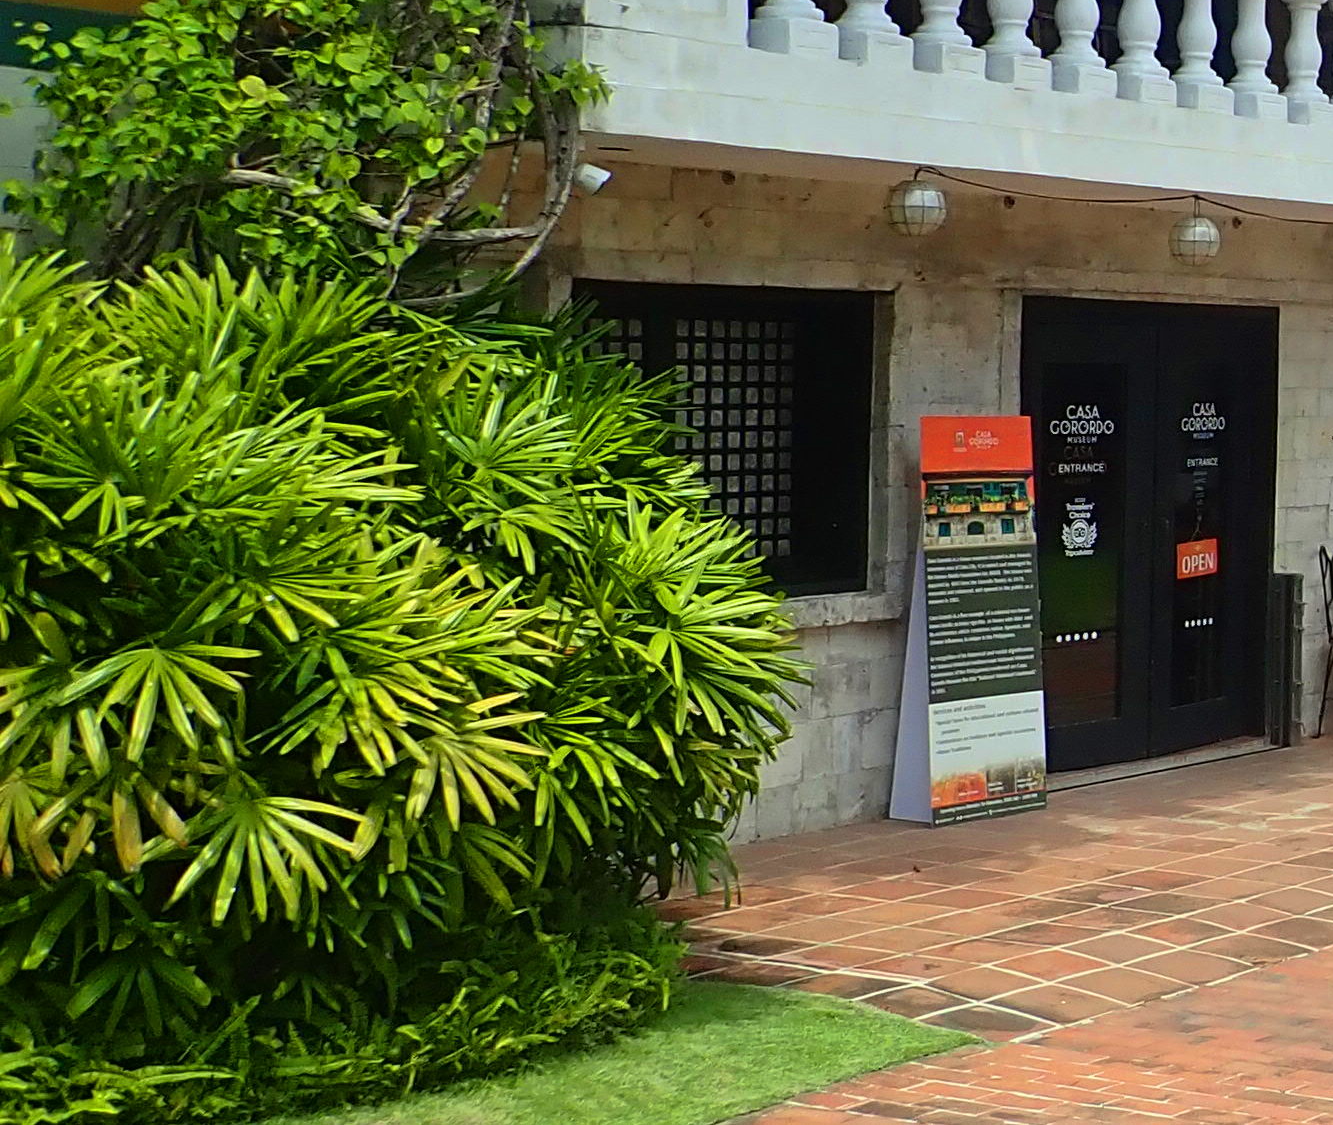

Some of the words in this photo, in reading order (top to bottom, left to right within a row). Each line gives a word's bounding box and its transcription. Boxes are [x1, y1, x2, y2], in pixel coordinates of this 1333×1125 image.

[1066, 405, 1100, 420] CASA
[1192, 402, 1216, 416] CASA
[1049, 420, 1115, 435] GORORDO
[1181, 416, 1226, 432] GORORDO
[1067, 436, 1098, 444] MUSEUM
[1058, 462, 1105, 474] ENTRANCE
[1186, 457, 1219, 468] ENTRANCE
[1181, 552, 1215, 574] OPEN
